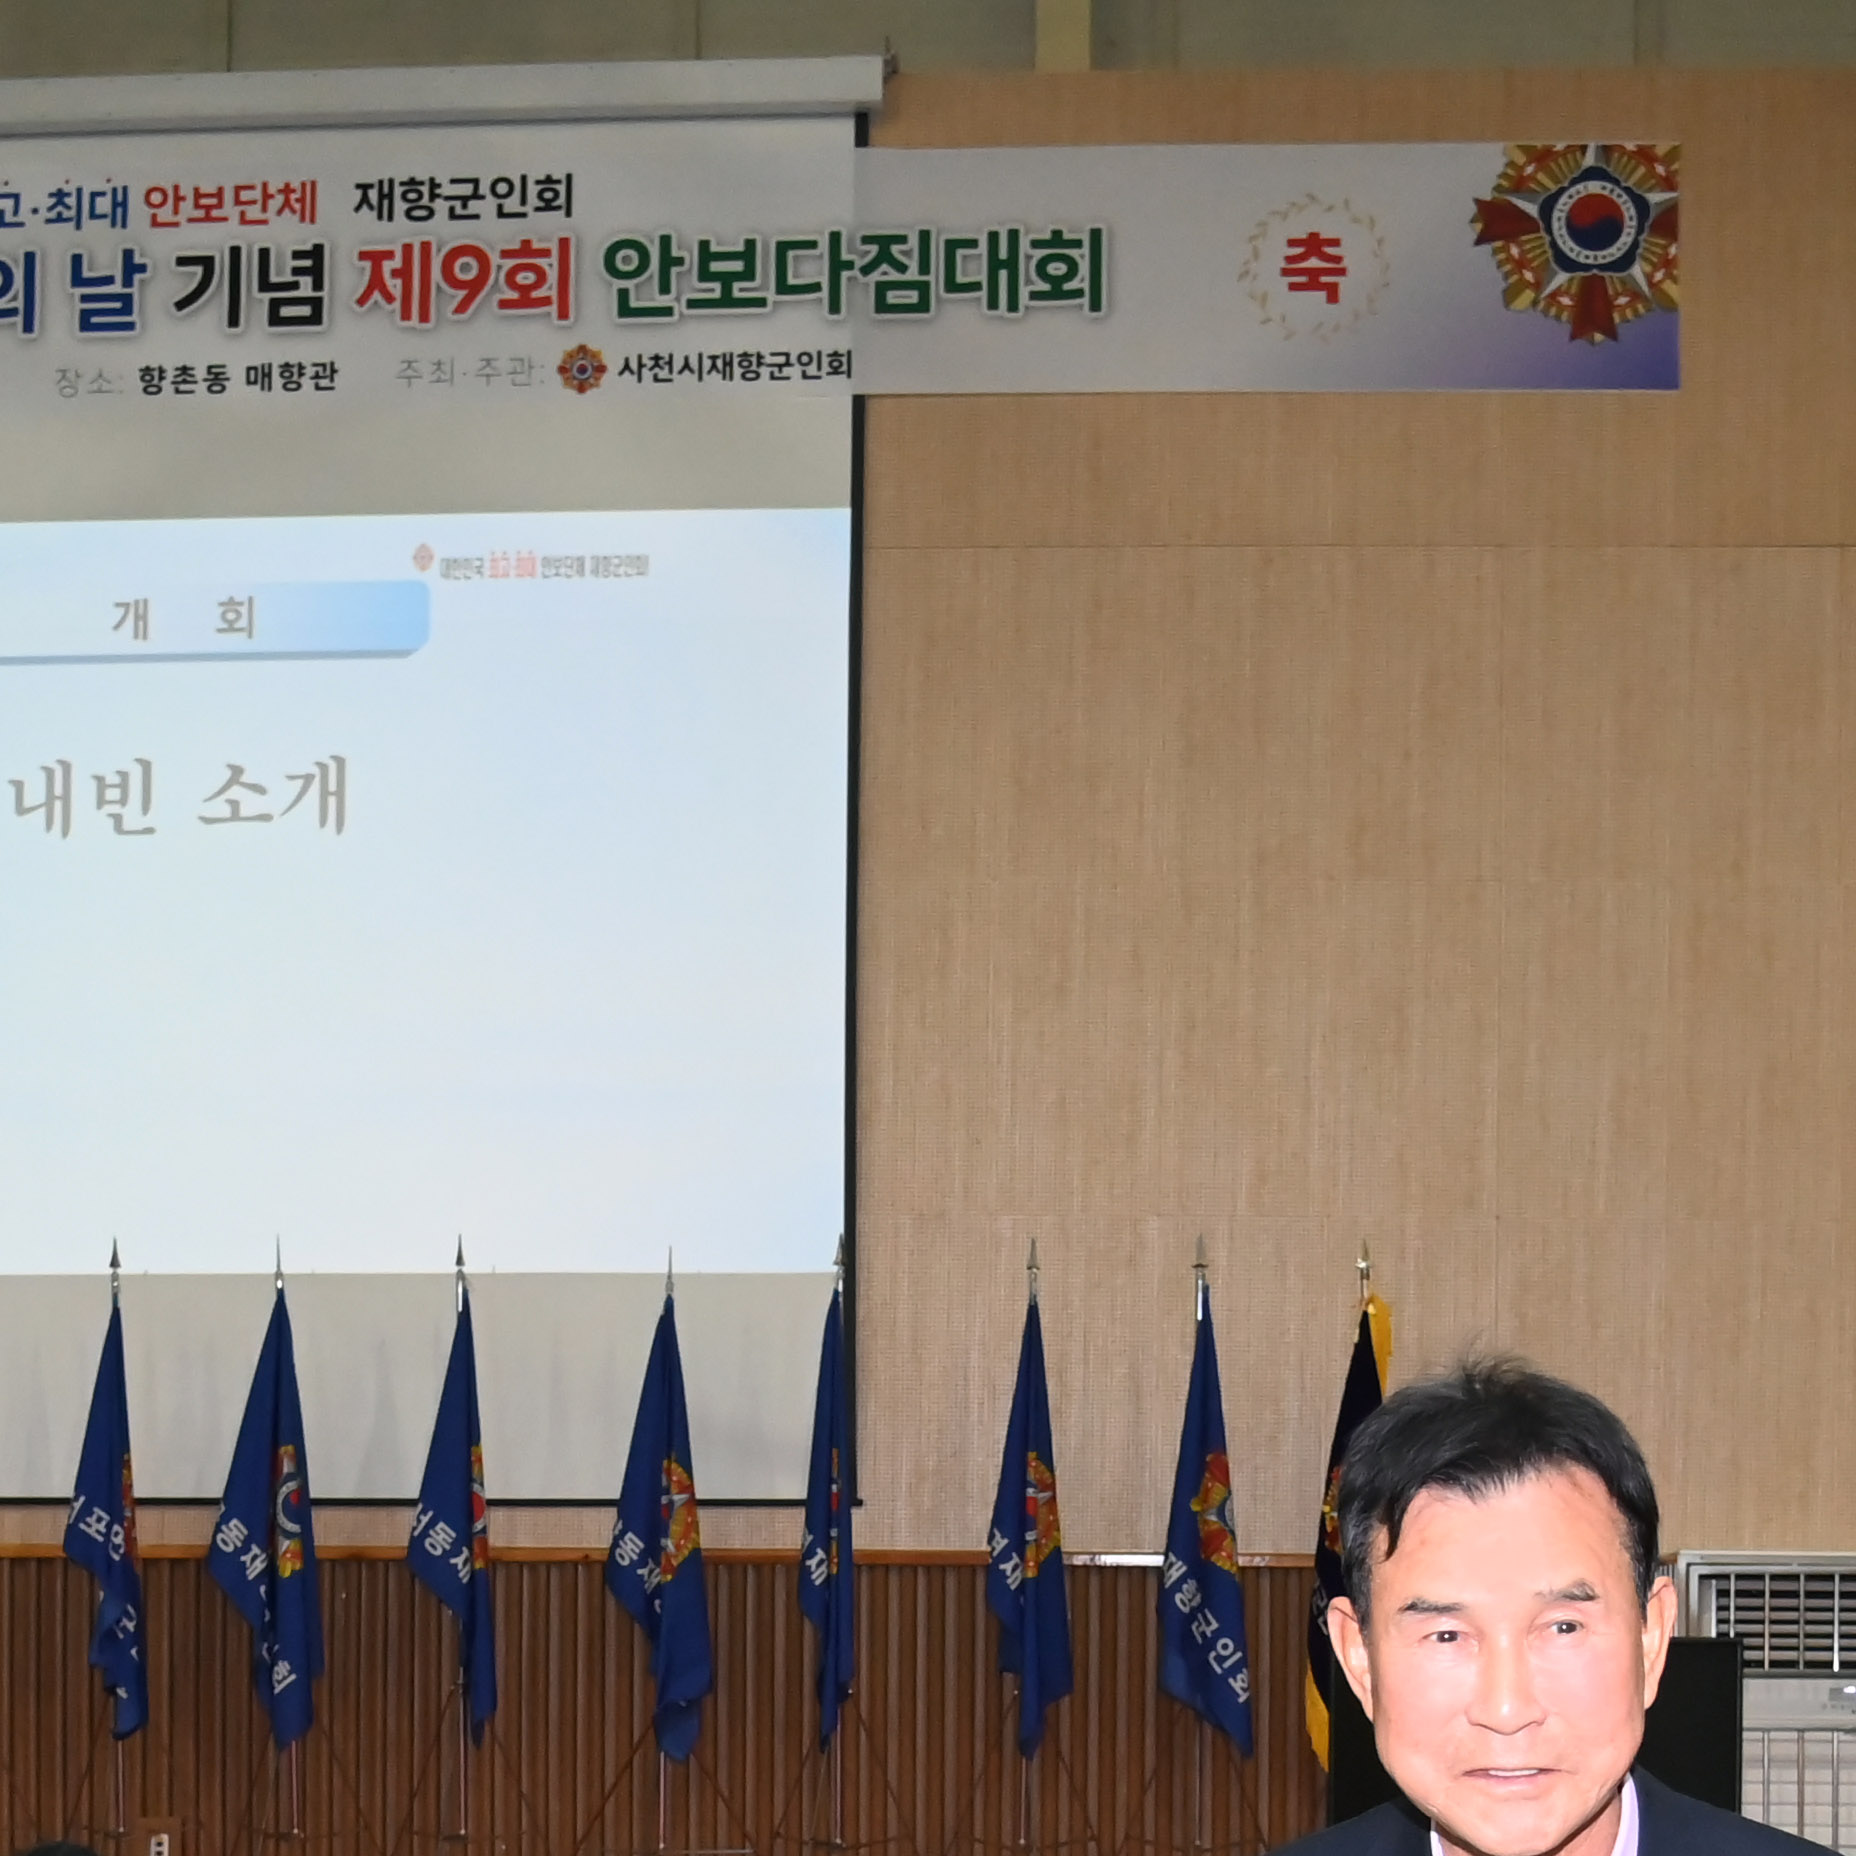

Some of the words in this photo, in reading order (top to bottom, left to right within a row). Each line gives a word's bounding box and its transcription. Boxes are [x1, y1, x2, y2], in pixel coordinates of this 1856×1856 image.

[144, 178, 318, 228] 안보단체
[353, 173, 574, 222] 재향군인회
[70, 249, 146, 333] 날
[172, 244, 325, 329] 기념
[355, 237, 571, 325] 제9회
[603, 227, 1105, 320] 안보다짐대회
[1280, 231, 1347, 305] 축
[138, 363, 231, 395] 향촌동
[246, 360, 339, 392] 매향관
[618, 350, 854, 383] 사천시재향군인회
[7, 757, 157, 840] 내빈
[196, 754, 348, 836] 소개
